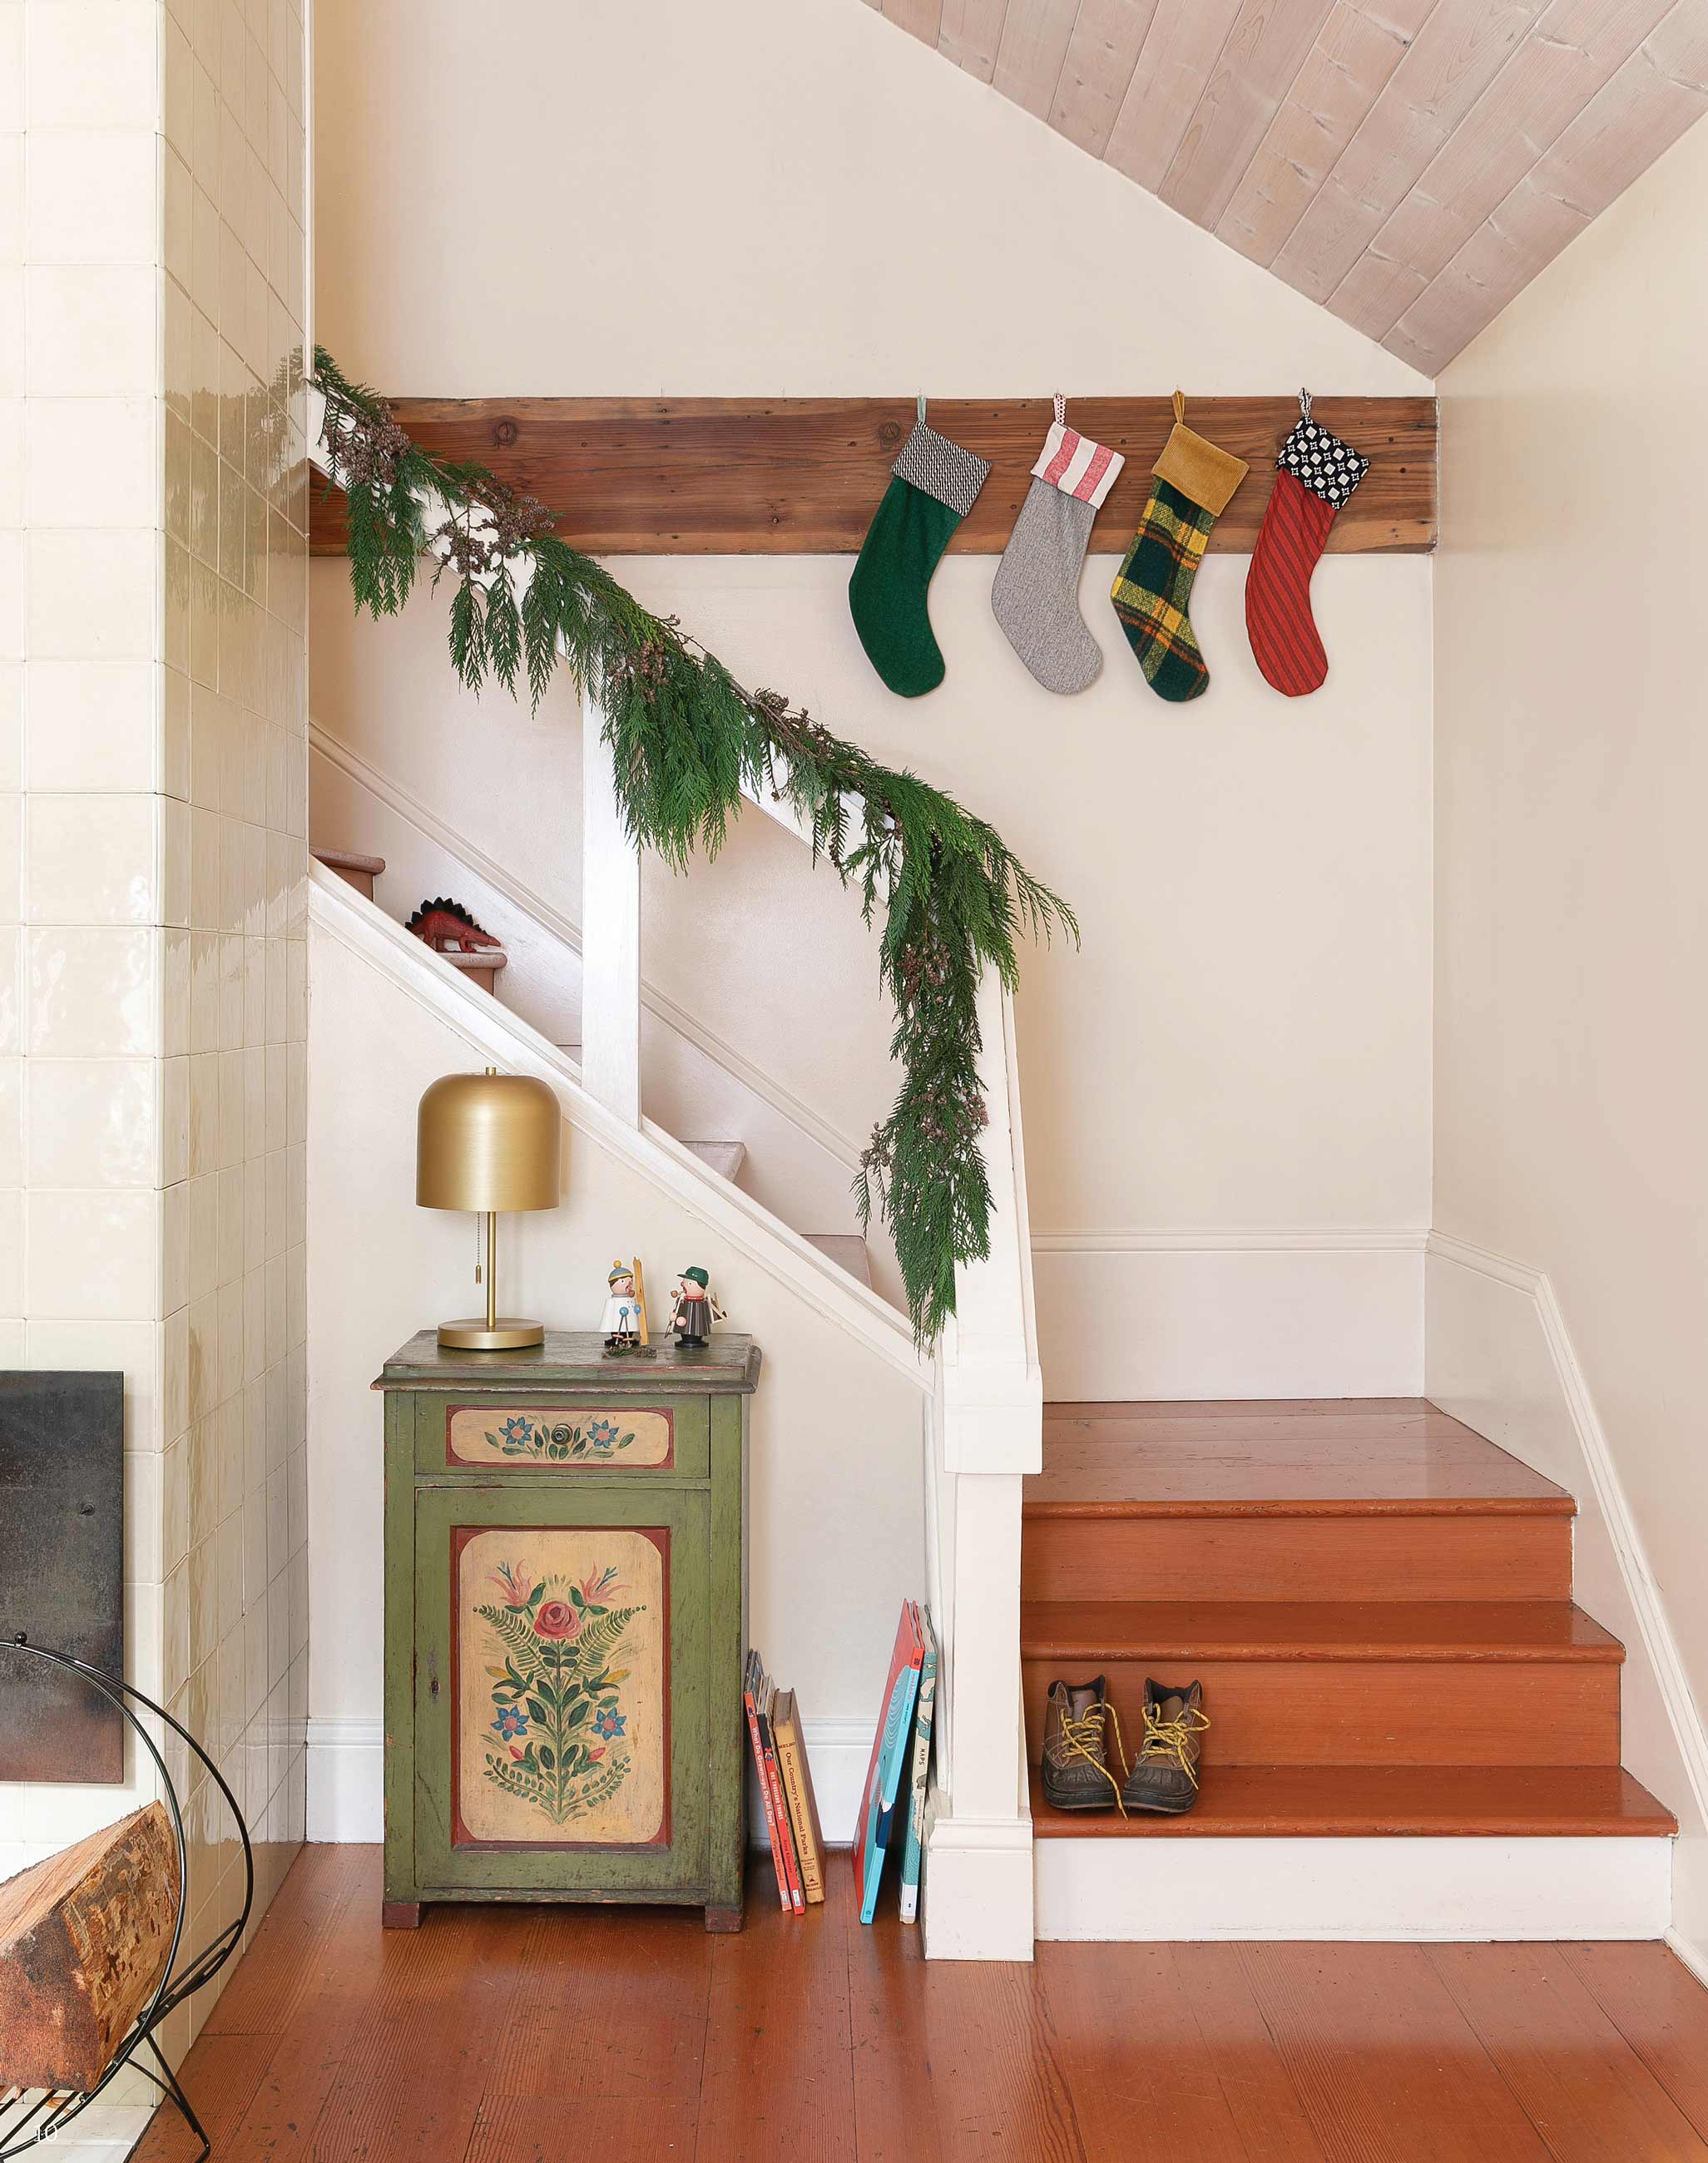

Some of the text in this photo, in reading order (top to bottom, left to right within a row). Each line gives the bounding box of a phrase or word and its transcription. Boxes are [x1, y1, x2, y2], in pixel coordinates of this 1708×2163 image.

[755, 1745, 761, 1755] Do
[758, 1755, 766, 1789] Grown-ups
[763, 1790, 769, 1799] Do
[771, 1781, 780, 1804] THOUSAND
[788, 1767, 799, 1801] Country's
[795, 1802, 804, 1833] National
[800, 1834, 809, 1855] Parks
